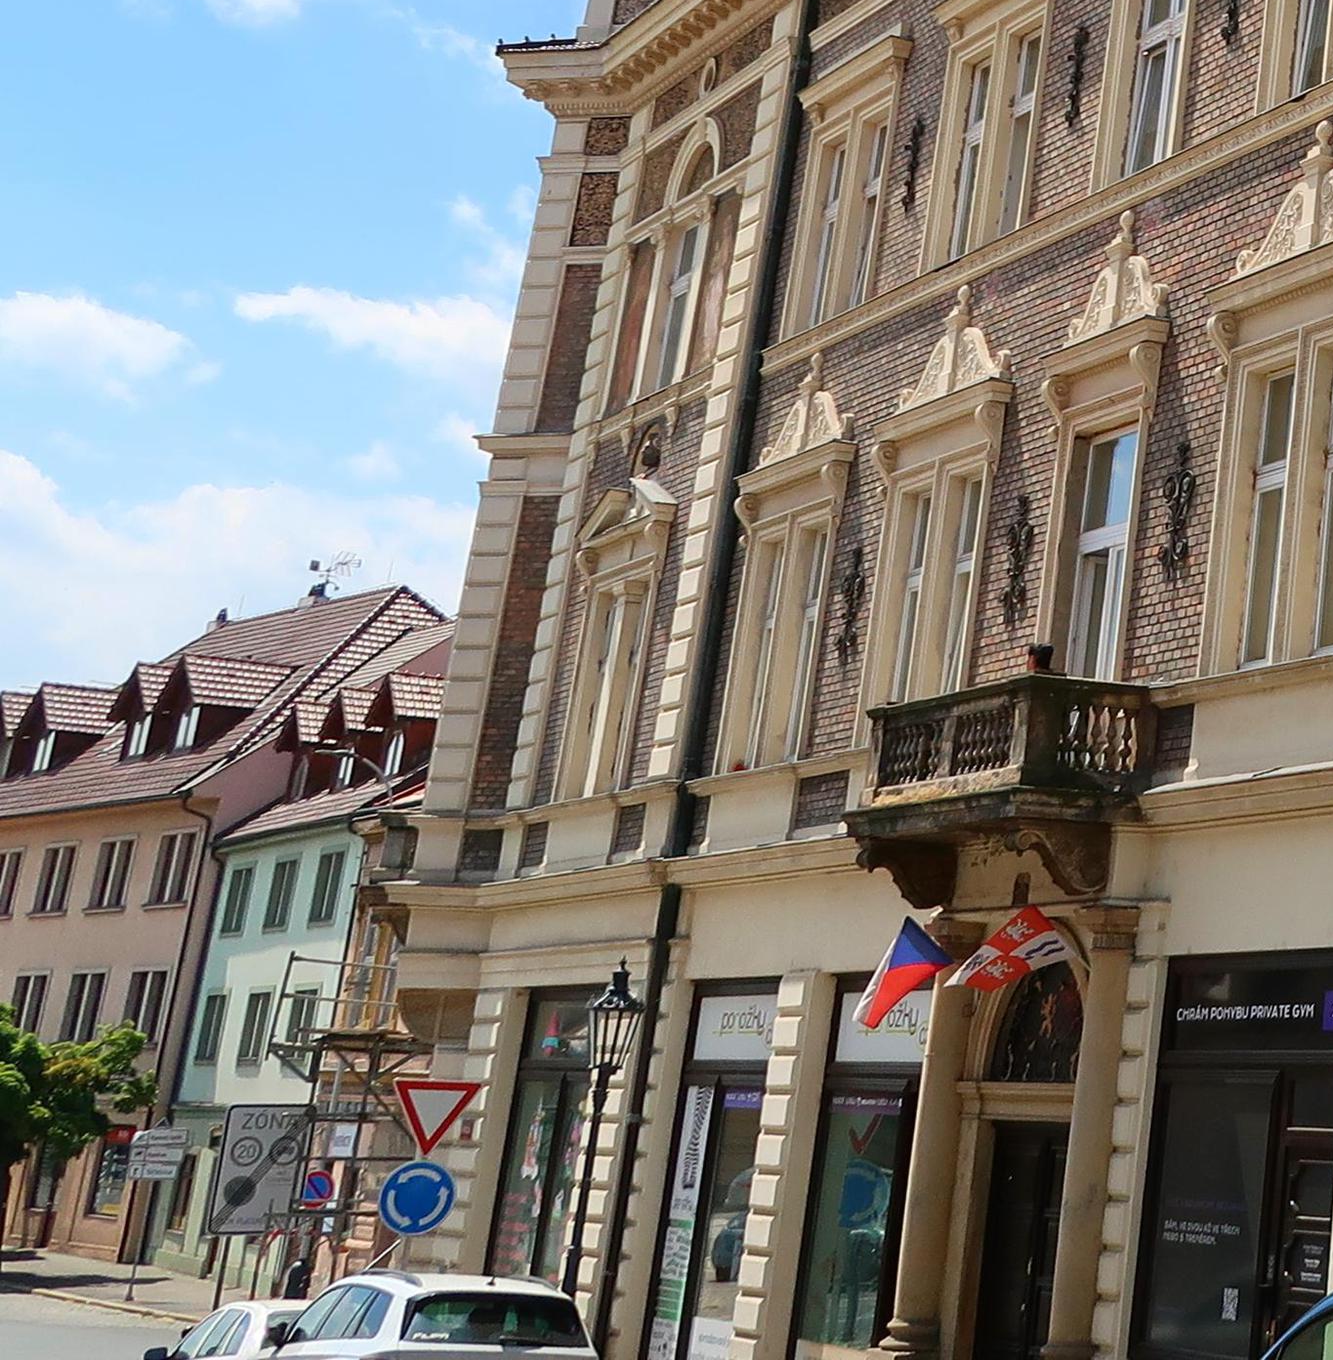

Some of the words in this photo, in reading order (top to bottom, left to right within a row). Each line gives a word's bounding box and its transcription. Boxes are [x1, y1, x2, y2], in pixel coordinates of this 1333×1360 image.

[1176, 1004, 1208, 1021] CHRÁM
[1210, 1005, 1249, 1020] POHYBU
[1250, 1004, 1291, 1019] PRIVATE
[1292, 1003, 1315, 1018] GYM
[237, 1144, 257, 1160] 20
